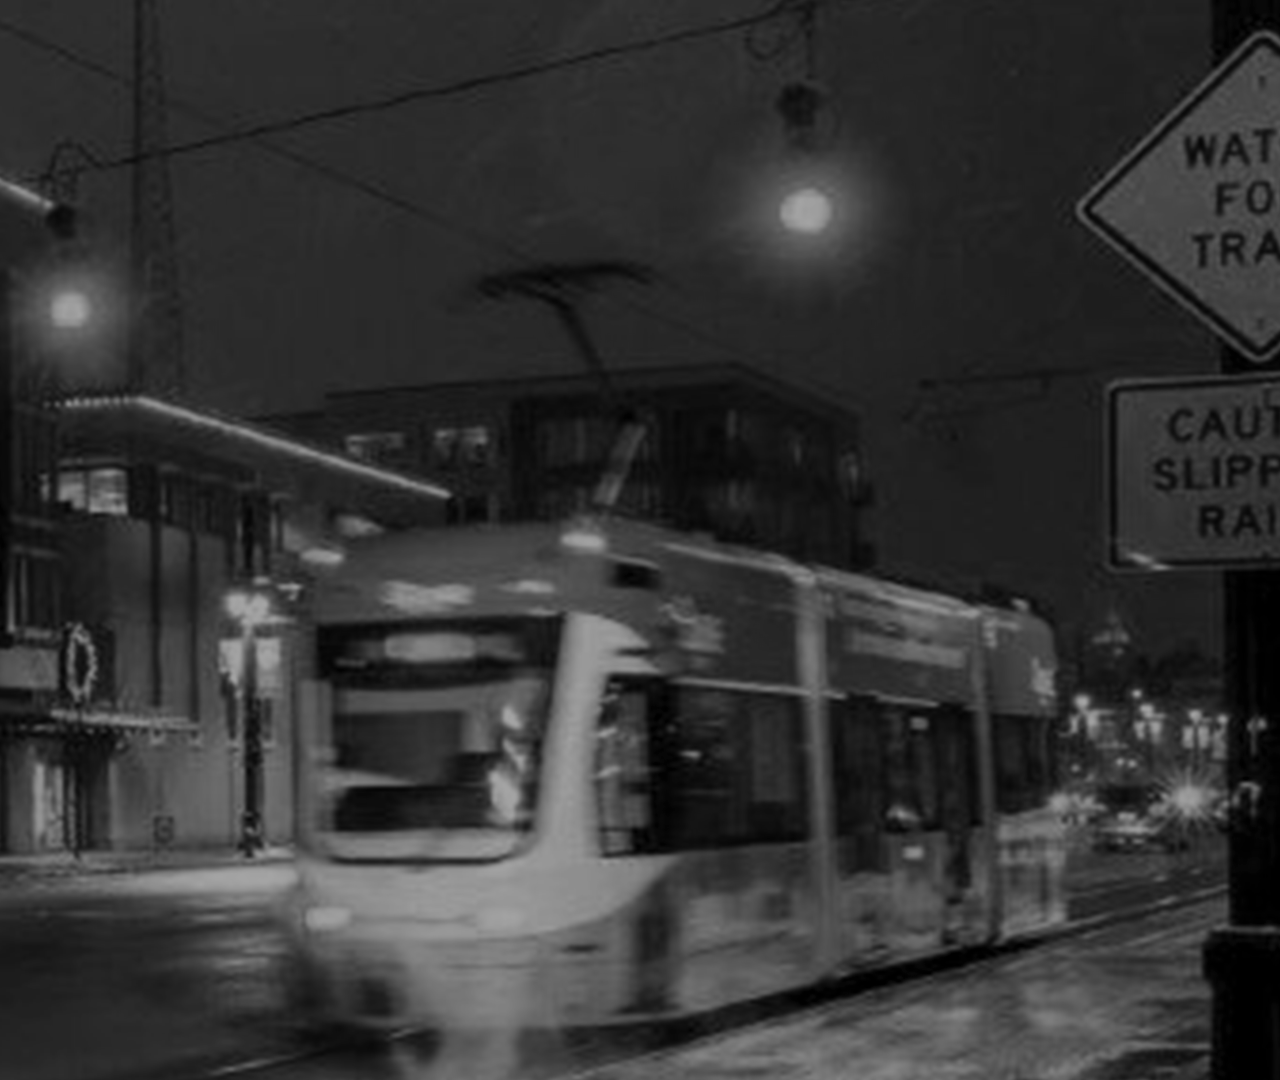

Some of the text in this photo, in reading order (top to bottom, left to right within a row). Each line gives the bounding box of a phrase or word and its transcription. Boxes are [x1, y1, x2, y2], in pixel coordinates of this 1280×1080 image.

[1184, 128, 1276, 168] WAT
[1215, 180, 1274, 217] FO
[1191, 229, 1280, 268] TRA
[1168, 405, 1280, 443] CAUT
[1153, 453, 1280, 491] SLIPP
[1198, 503, 1276, 538] RAI
